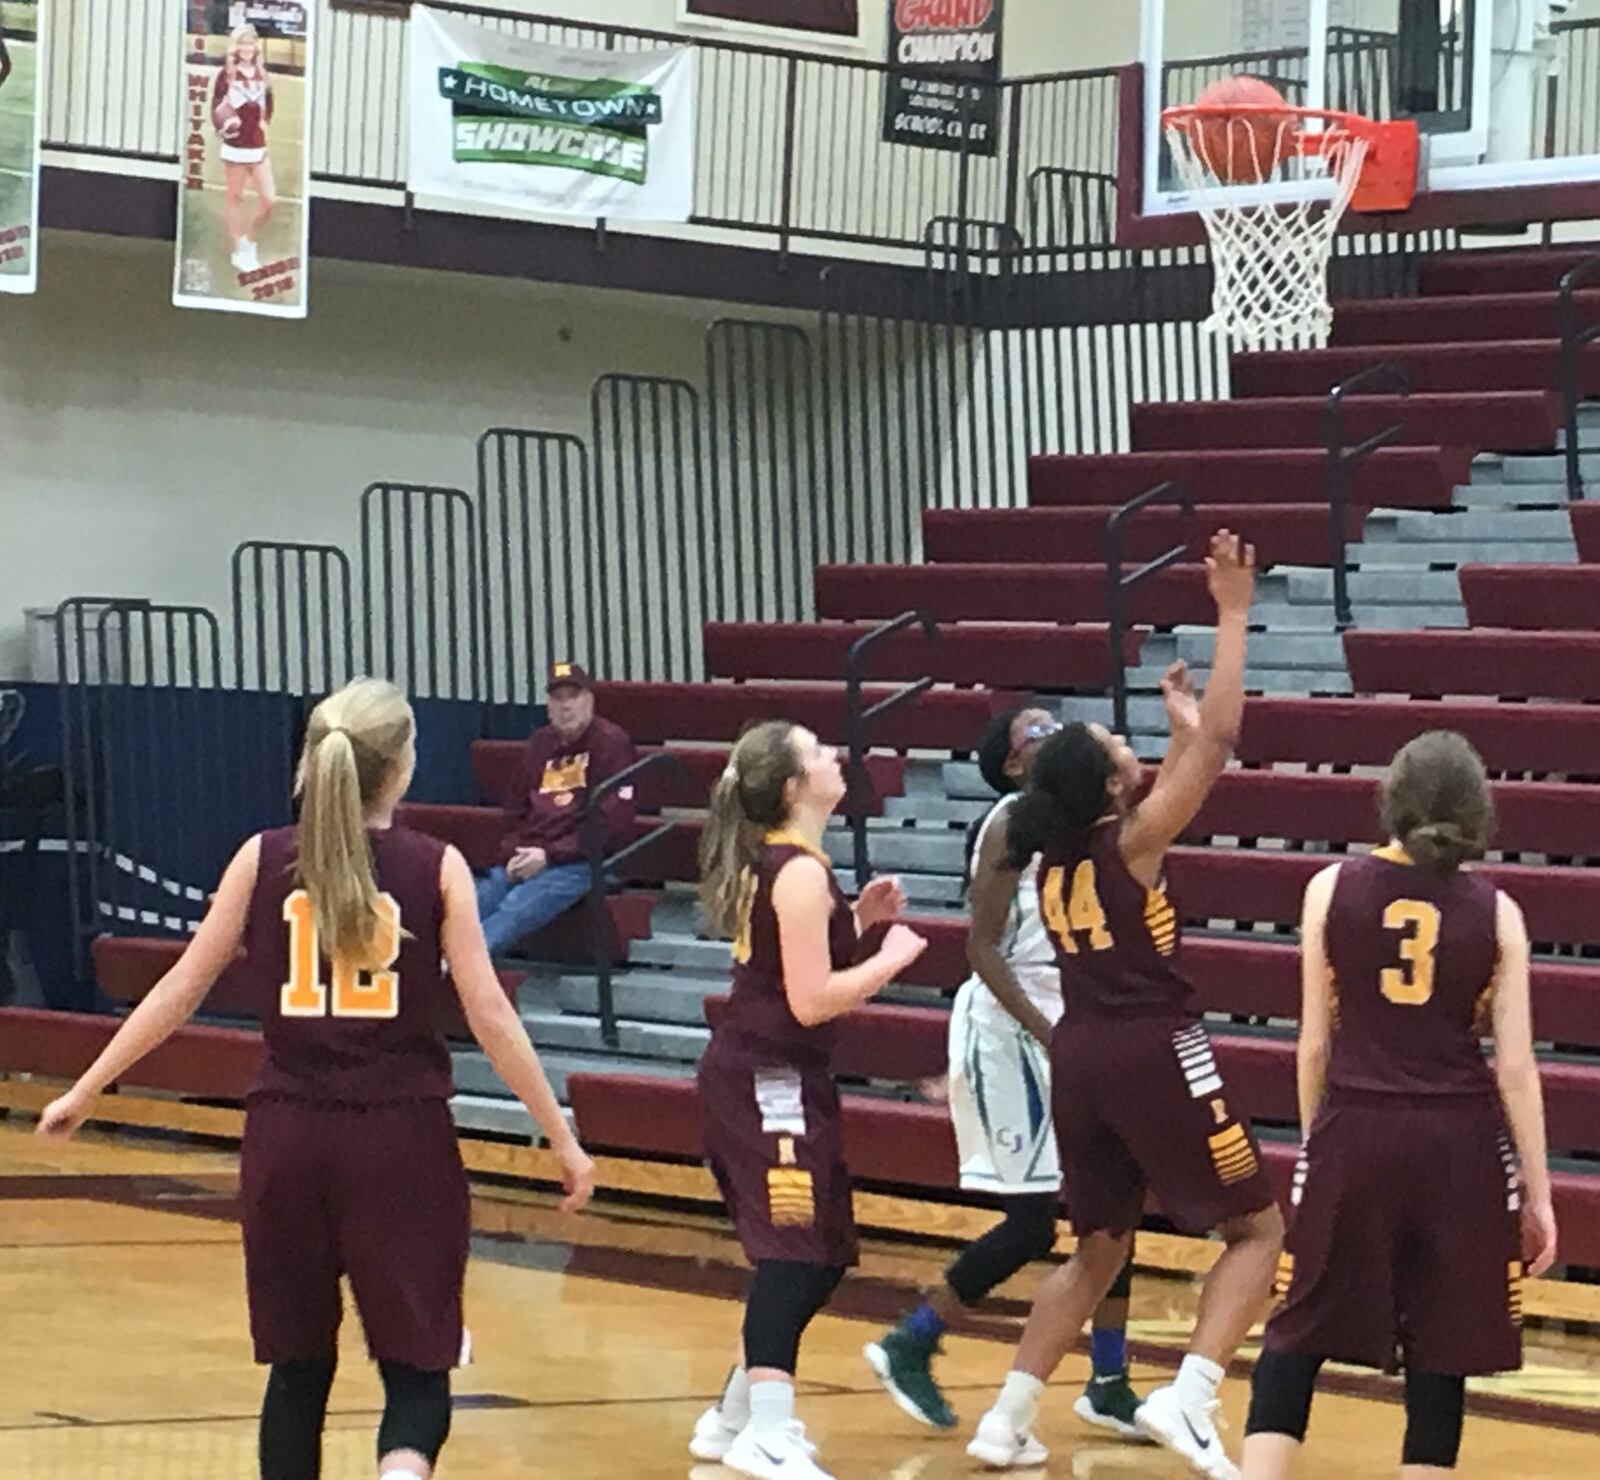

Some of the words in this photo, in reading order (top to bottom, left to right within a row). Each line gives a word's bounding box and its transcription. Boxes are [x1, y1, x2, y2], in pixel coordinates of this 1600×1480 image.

[464, 76, 645, 117] HOMETOWN
[456, 121, 646, 172] SHOWCASE
[280, 888, 401, 1018] 12
[1042, 859, 1114, 953] 44
[1380, 898, 1442, 1005] 3
